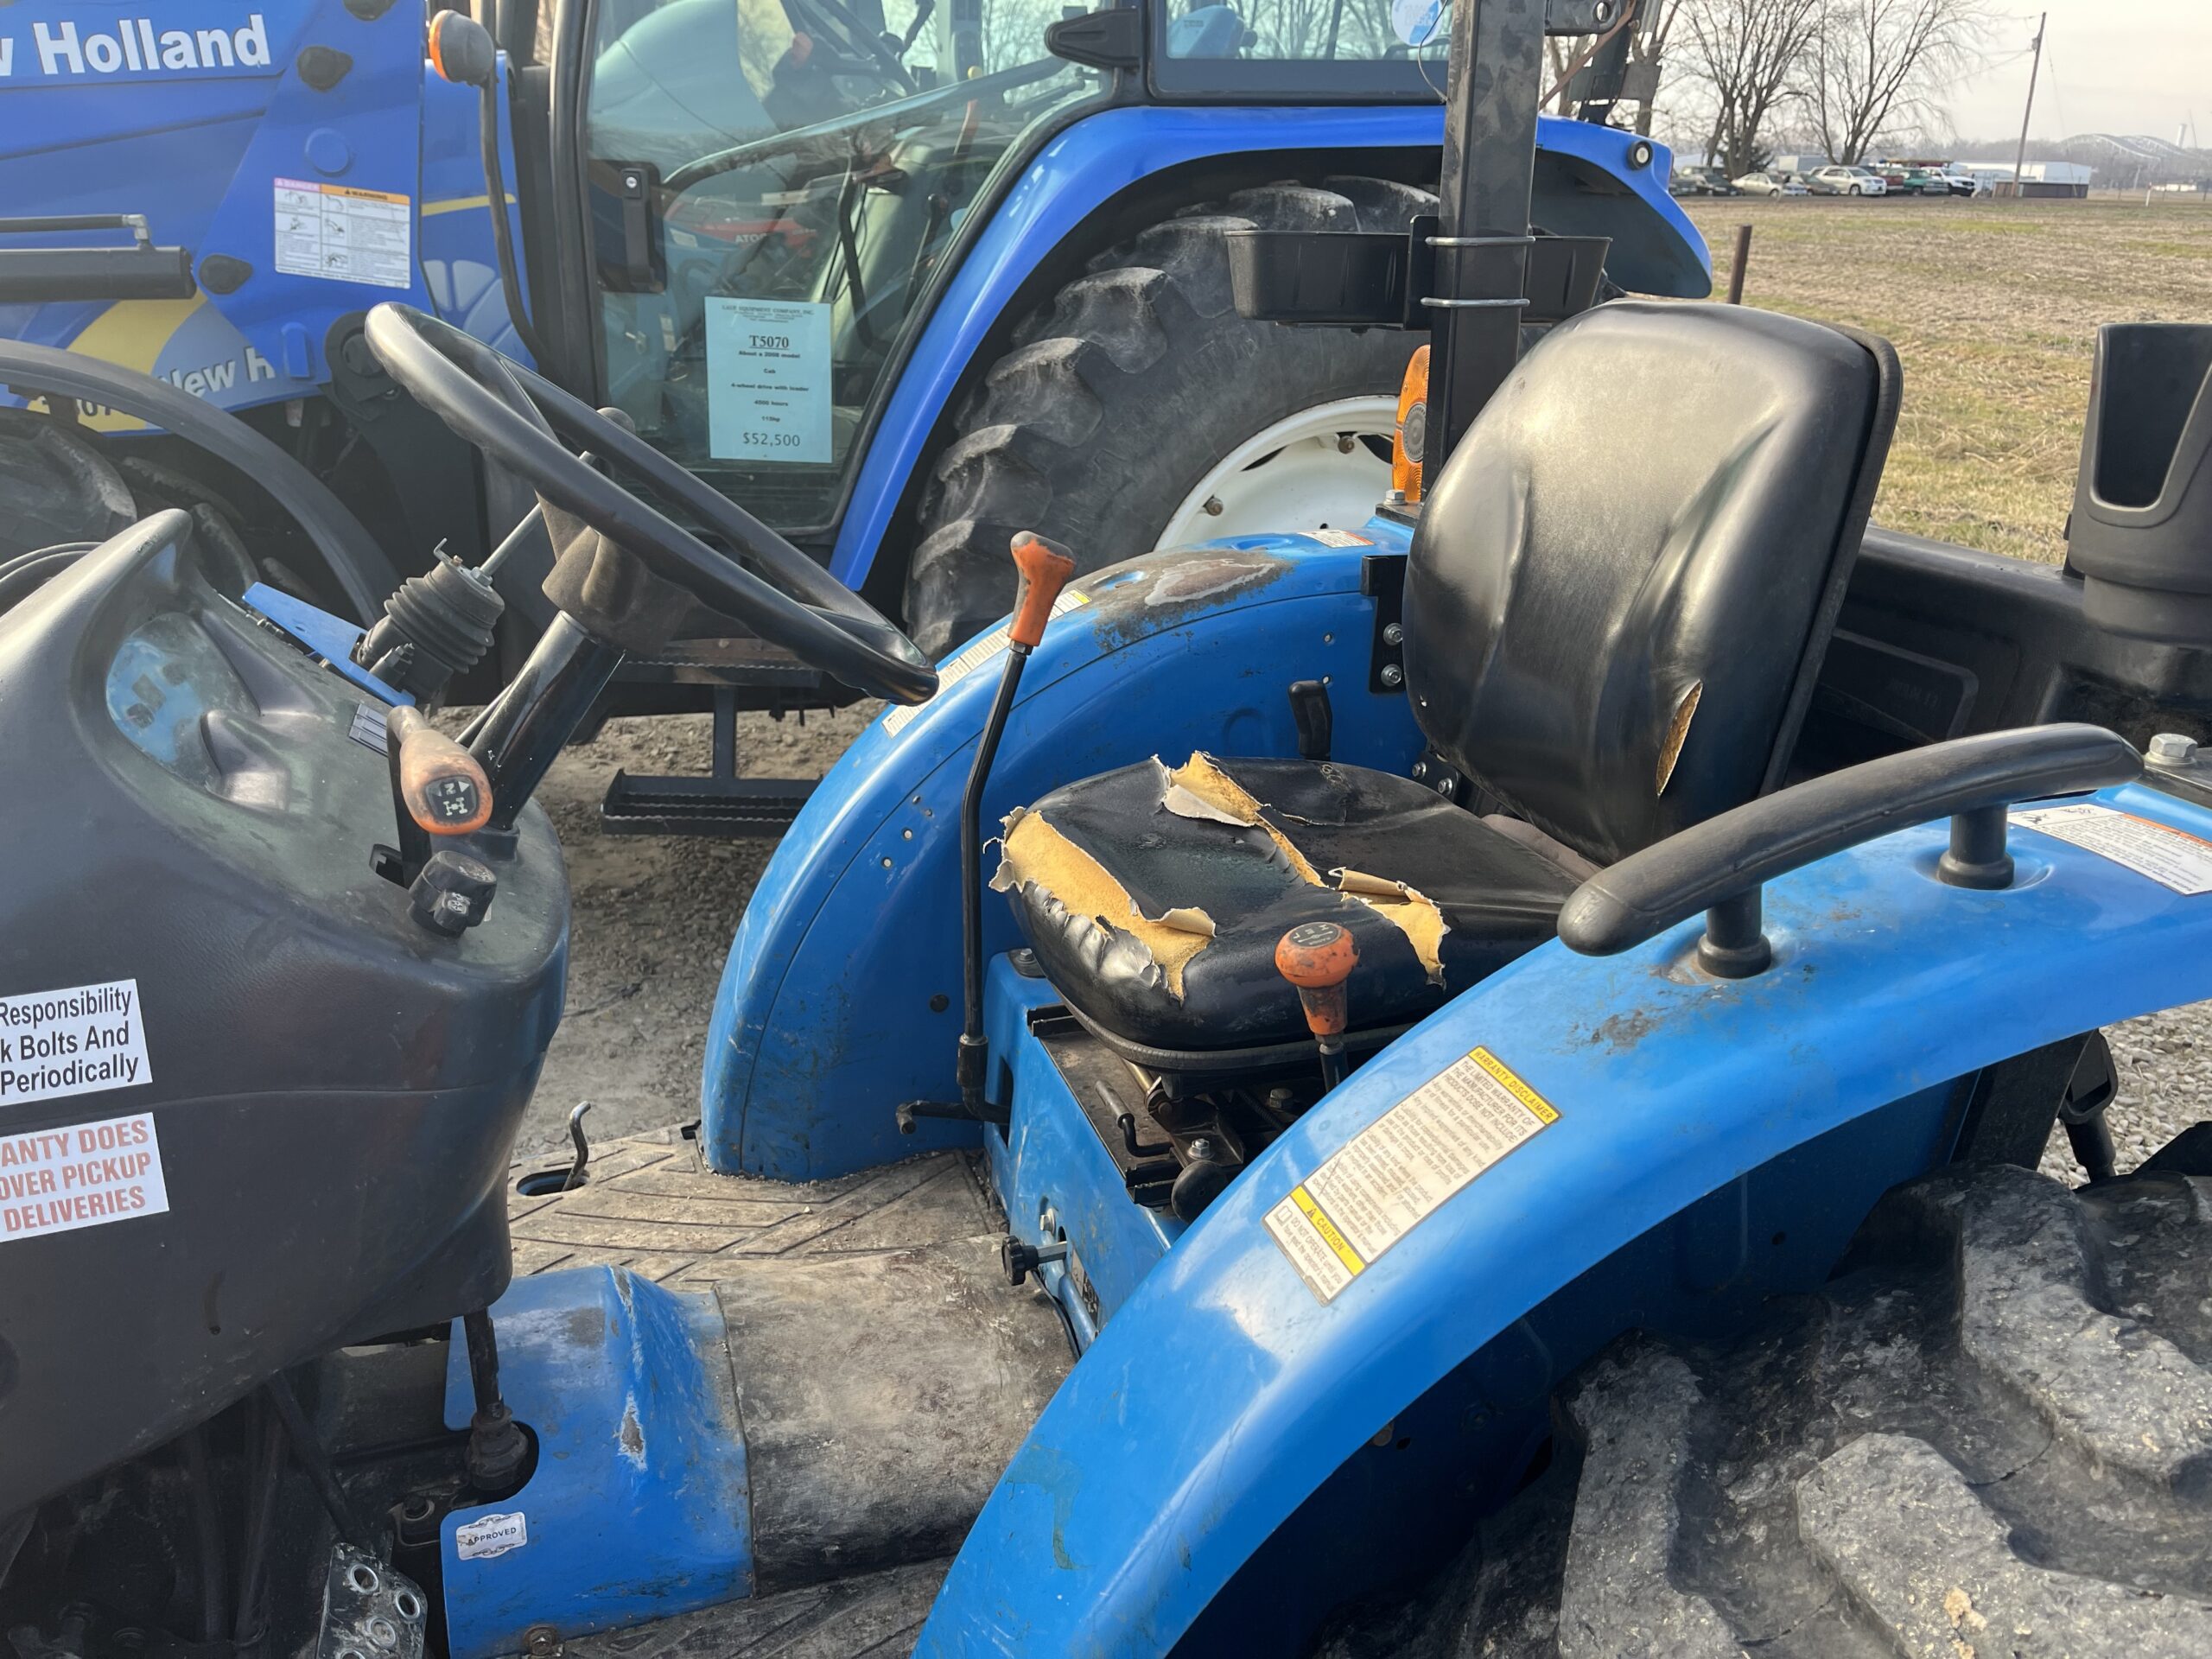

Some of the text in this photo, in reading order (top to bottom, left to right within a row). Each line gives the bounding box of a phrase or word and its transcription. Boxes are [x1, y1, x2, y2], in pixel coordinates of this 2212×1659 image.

[33, 15, 270, 75] Holland
[749, 335, 789, 348] T5070
[743, 432, 800, 447] $52,500
[0, 987, 131, 1029] Responsibility
[20, 1031, 78, 1061] Bolts
[85, 1020, 129, 1052] And
[1, 1052, 138, 1096] Periodically
[1472, 1049, 1556, 1121] WARRANTY DISCLAIMER
[1489, 1087, 1526, 1119] WARRANTY
[2, 1120, 149, 1166] ANTY DOES
[61, 1152, 151, 1189] PICKUP
[4, 1185, 146, 1232] DELIVERIES
[1314, 1217, 1345, 1251] CAUTION
[468, 1527, 517, 1544] APPROVED
